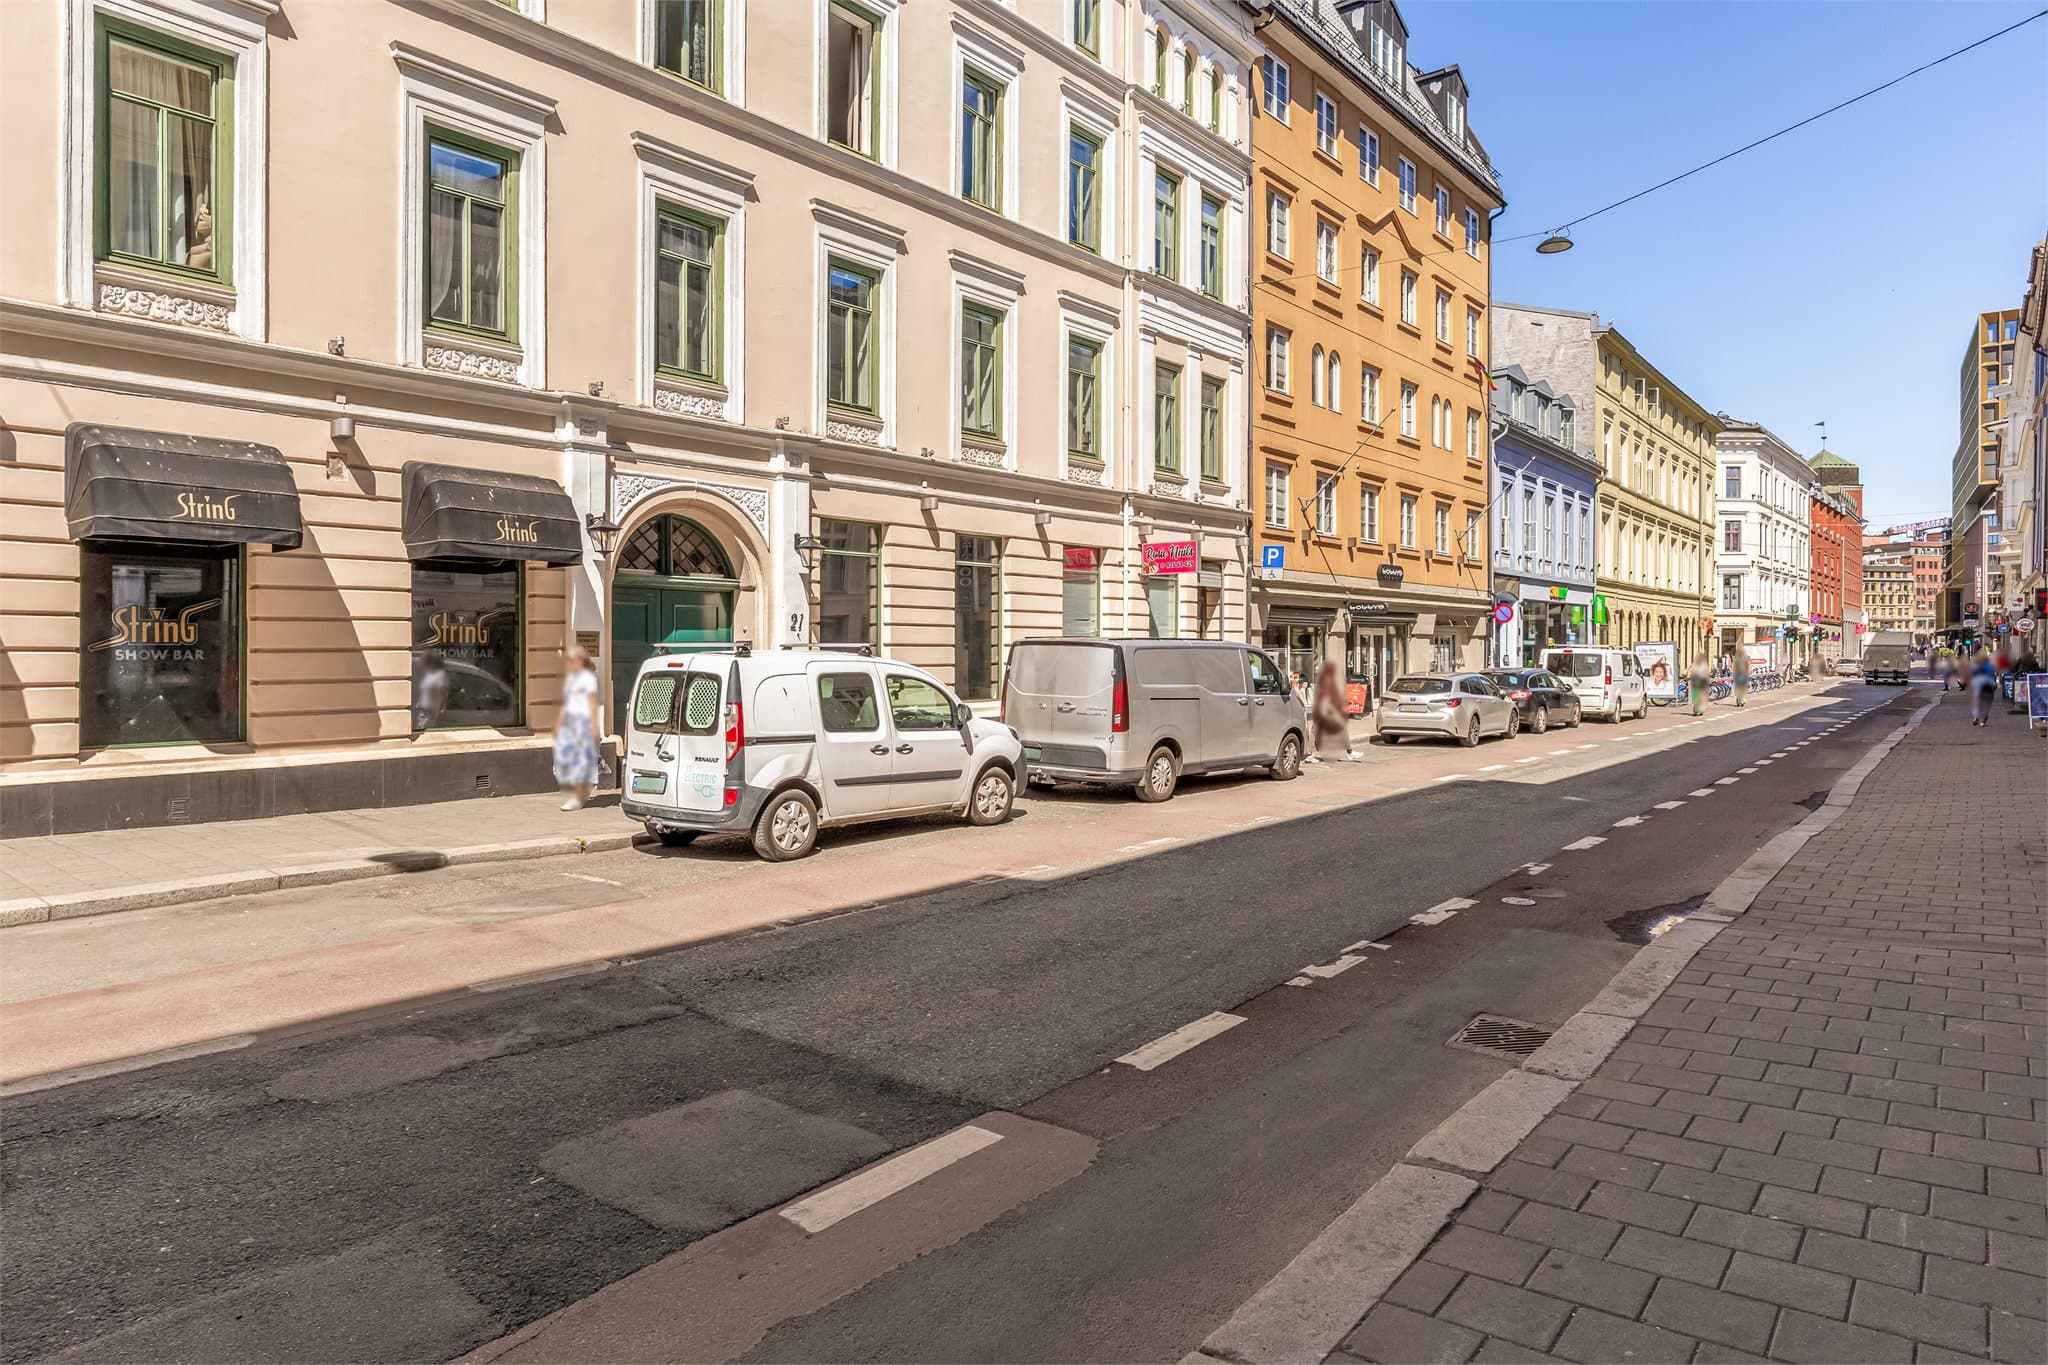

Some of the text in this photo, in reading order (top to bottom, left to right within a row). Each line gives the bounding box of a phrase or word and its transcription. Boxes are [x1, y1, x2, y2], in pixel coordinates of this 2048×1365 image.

[1267, 548, 1279, 565] P
[790, 613, 804, 632] 21
[115, 649, 204, 661] SHOW BAR
[694, 755, 719, 763] RENAULT
